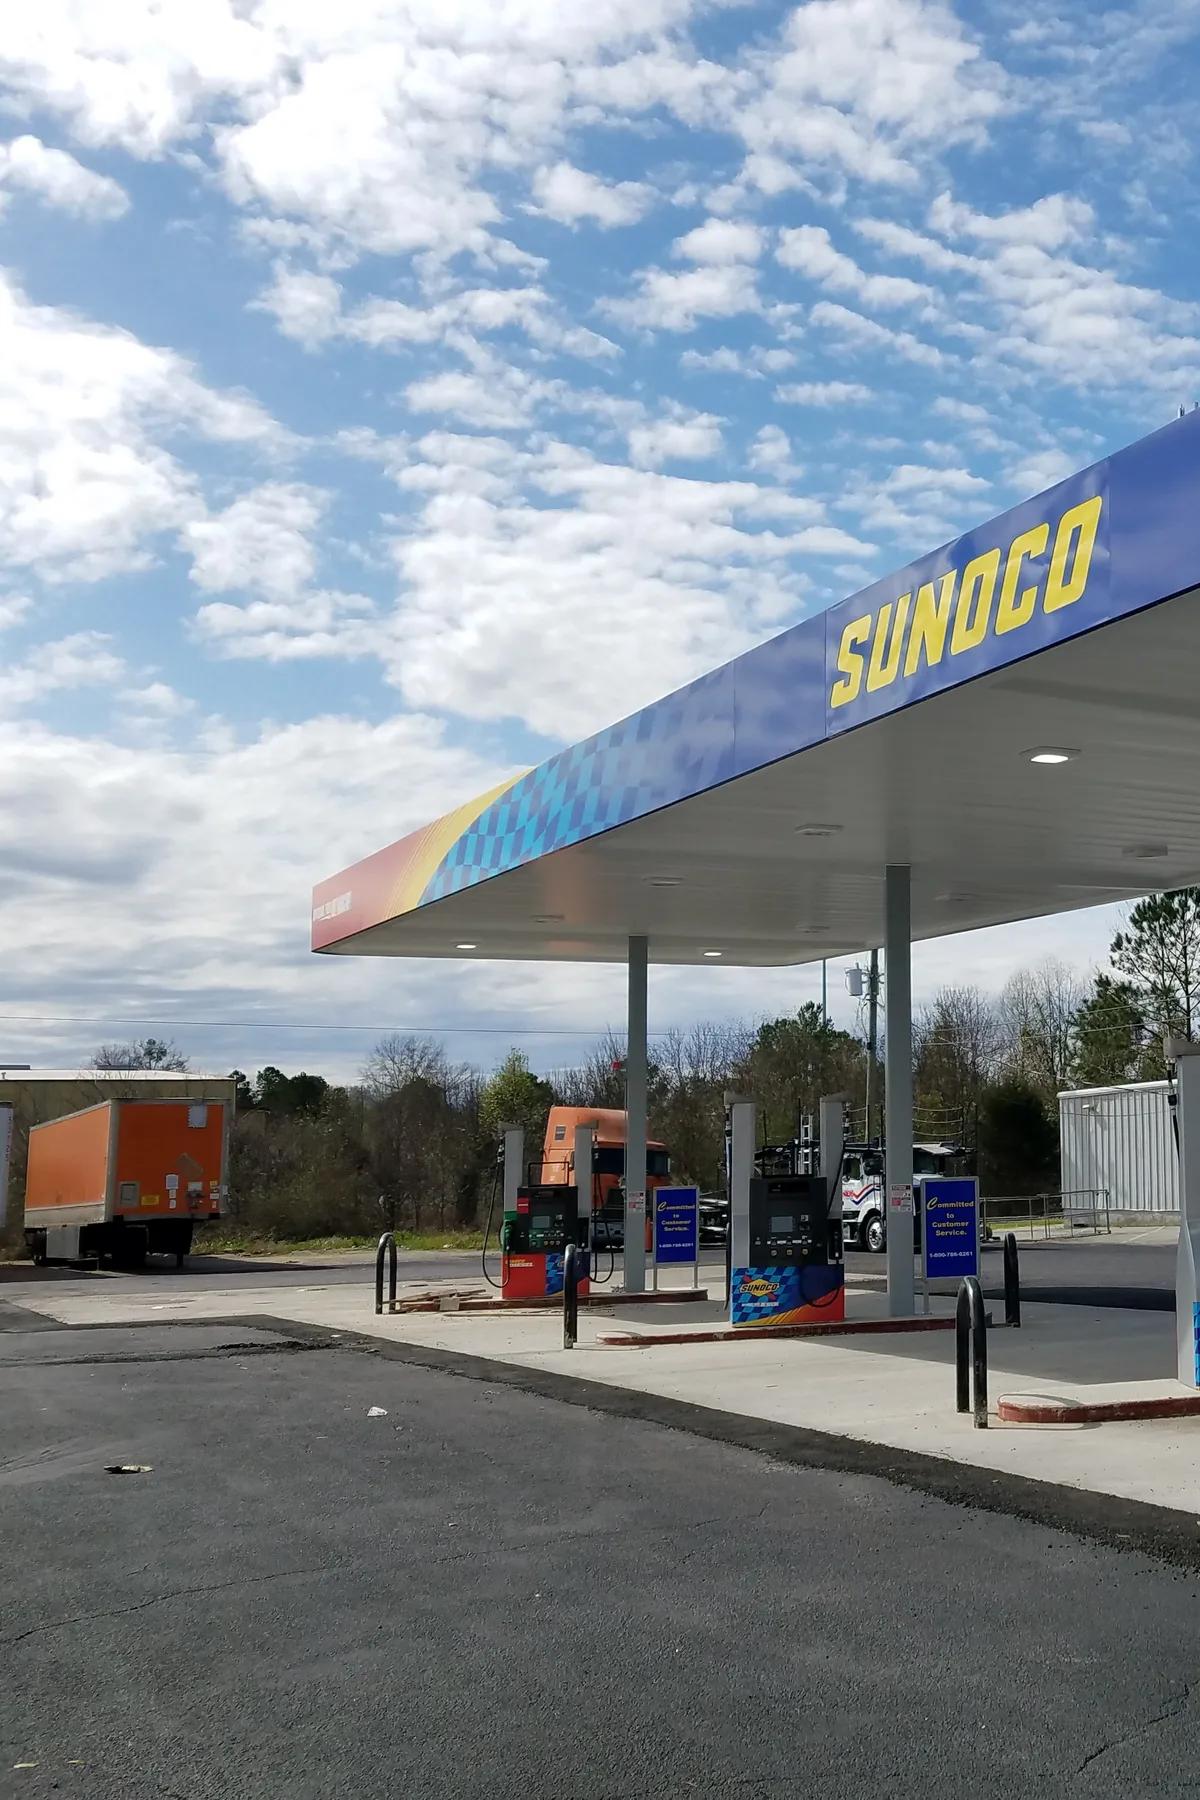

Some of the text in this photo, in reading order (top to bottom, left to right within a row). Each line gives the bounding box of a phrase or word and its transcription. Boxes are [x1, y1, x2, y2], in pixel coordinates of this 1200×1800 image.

[830, 495, 1103, 709] SUNOCO
[927, 1197, 974, 1210] Committed
[741, 1284, 778, 1292] SUNOCO
